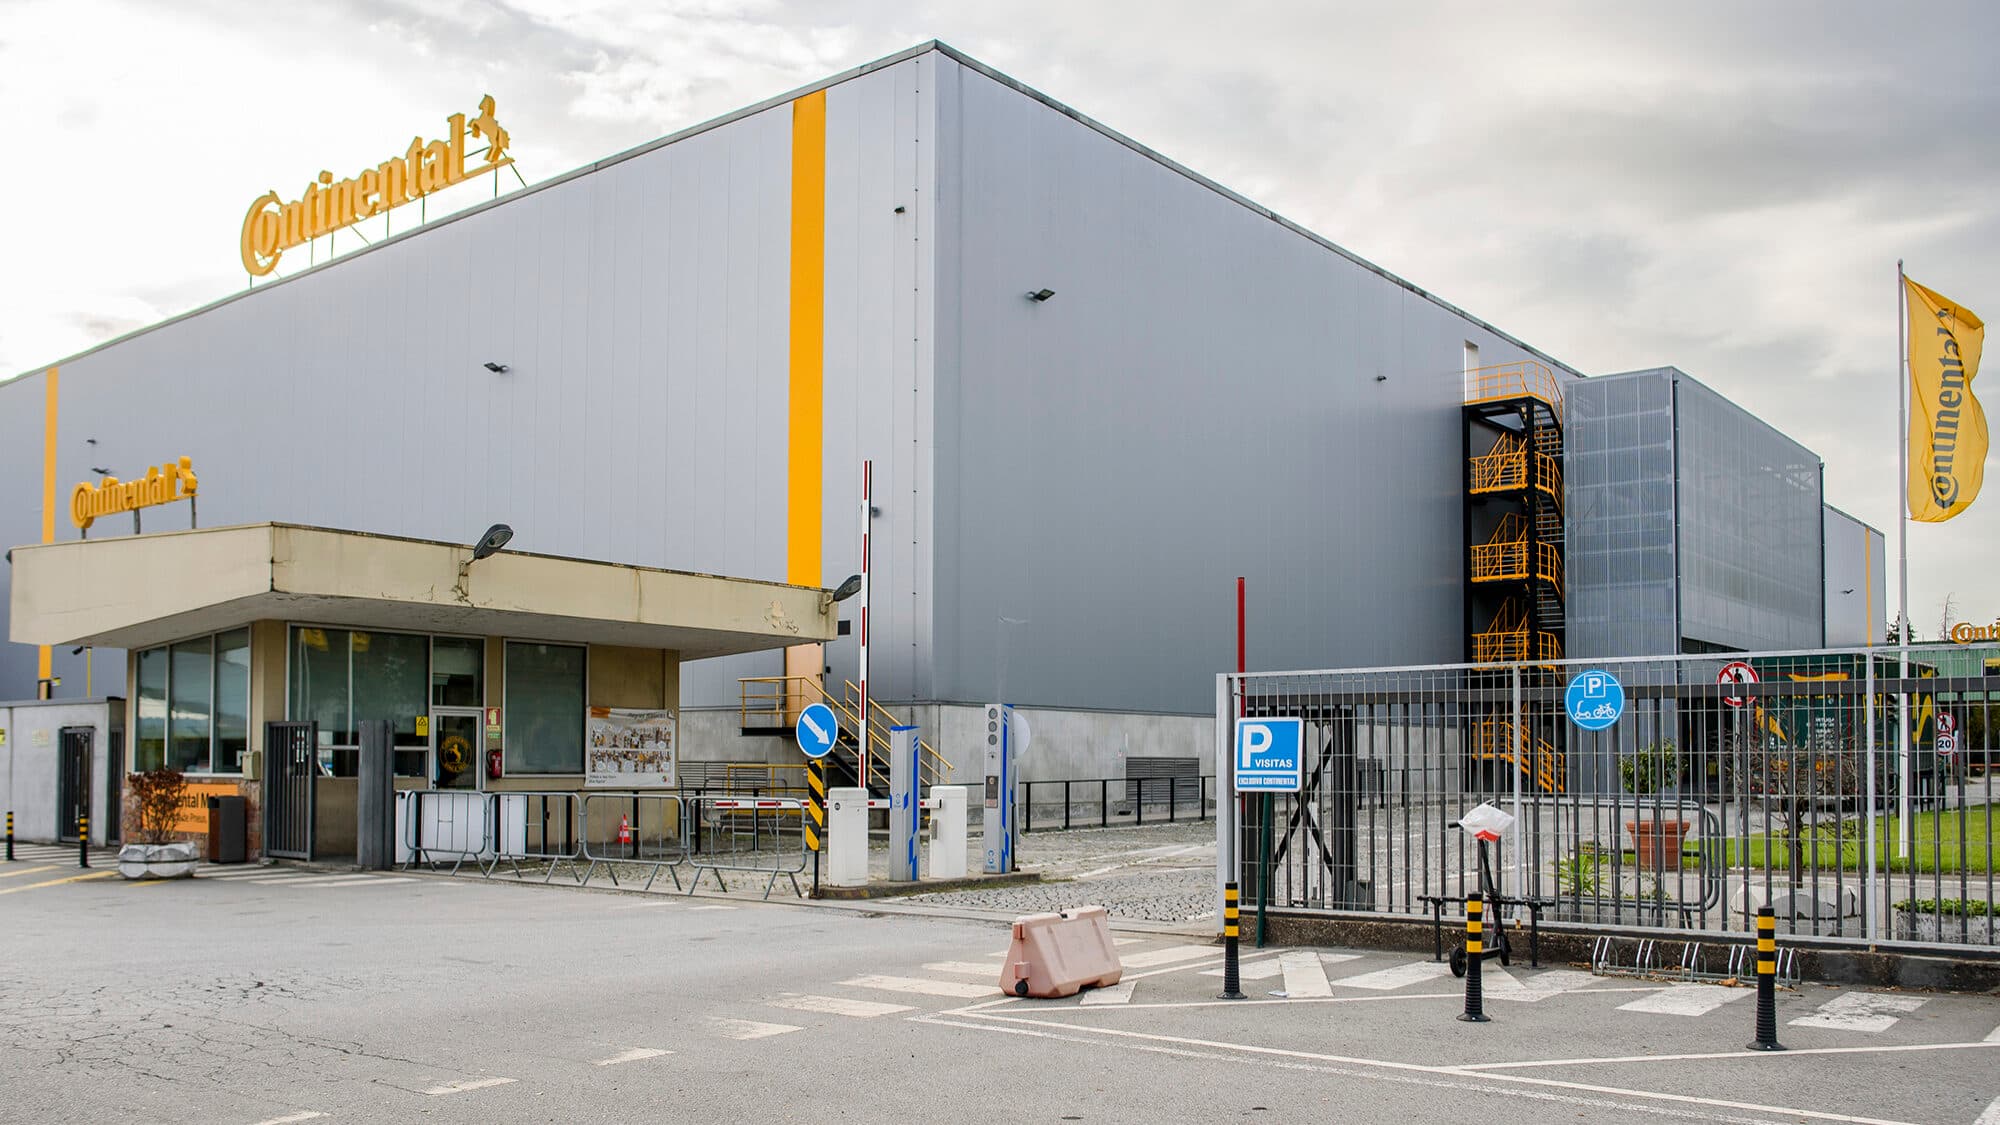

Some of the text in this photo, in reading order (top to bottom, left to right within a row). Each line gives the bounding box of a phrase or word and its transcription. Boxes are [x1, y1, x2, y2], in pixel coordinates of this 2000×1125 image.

[241, 112, 466, 276] Continental
[1930, 327, 1965, 509] Continental
[70, 463, 177, 529] Continental
[1589, 678, 1602, 694] P
[1242, 724, 1273, 768] P
[1255, 759, 1293, 768] VISITAS
[1938, 740, 1951, 749] 20
